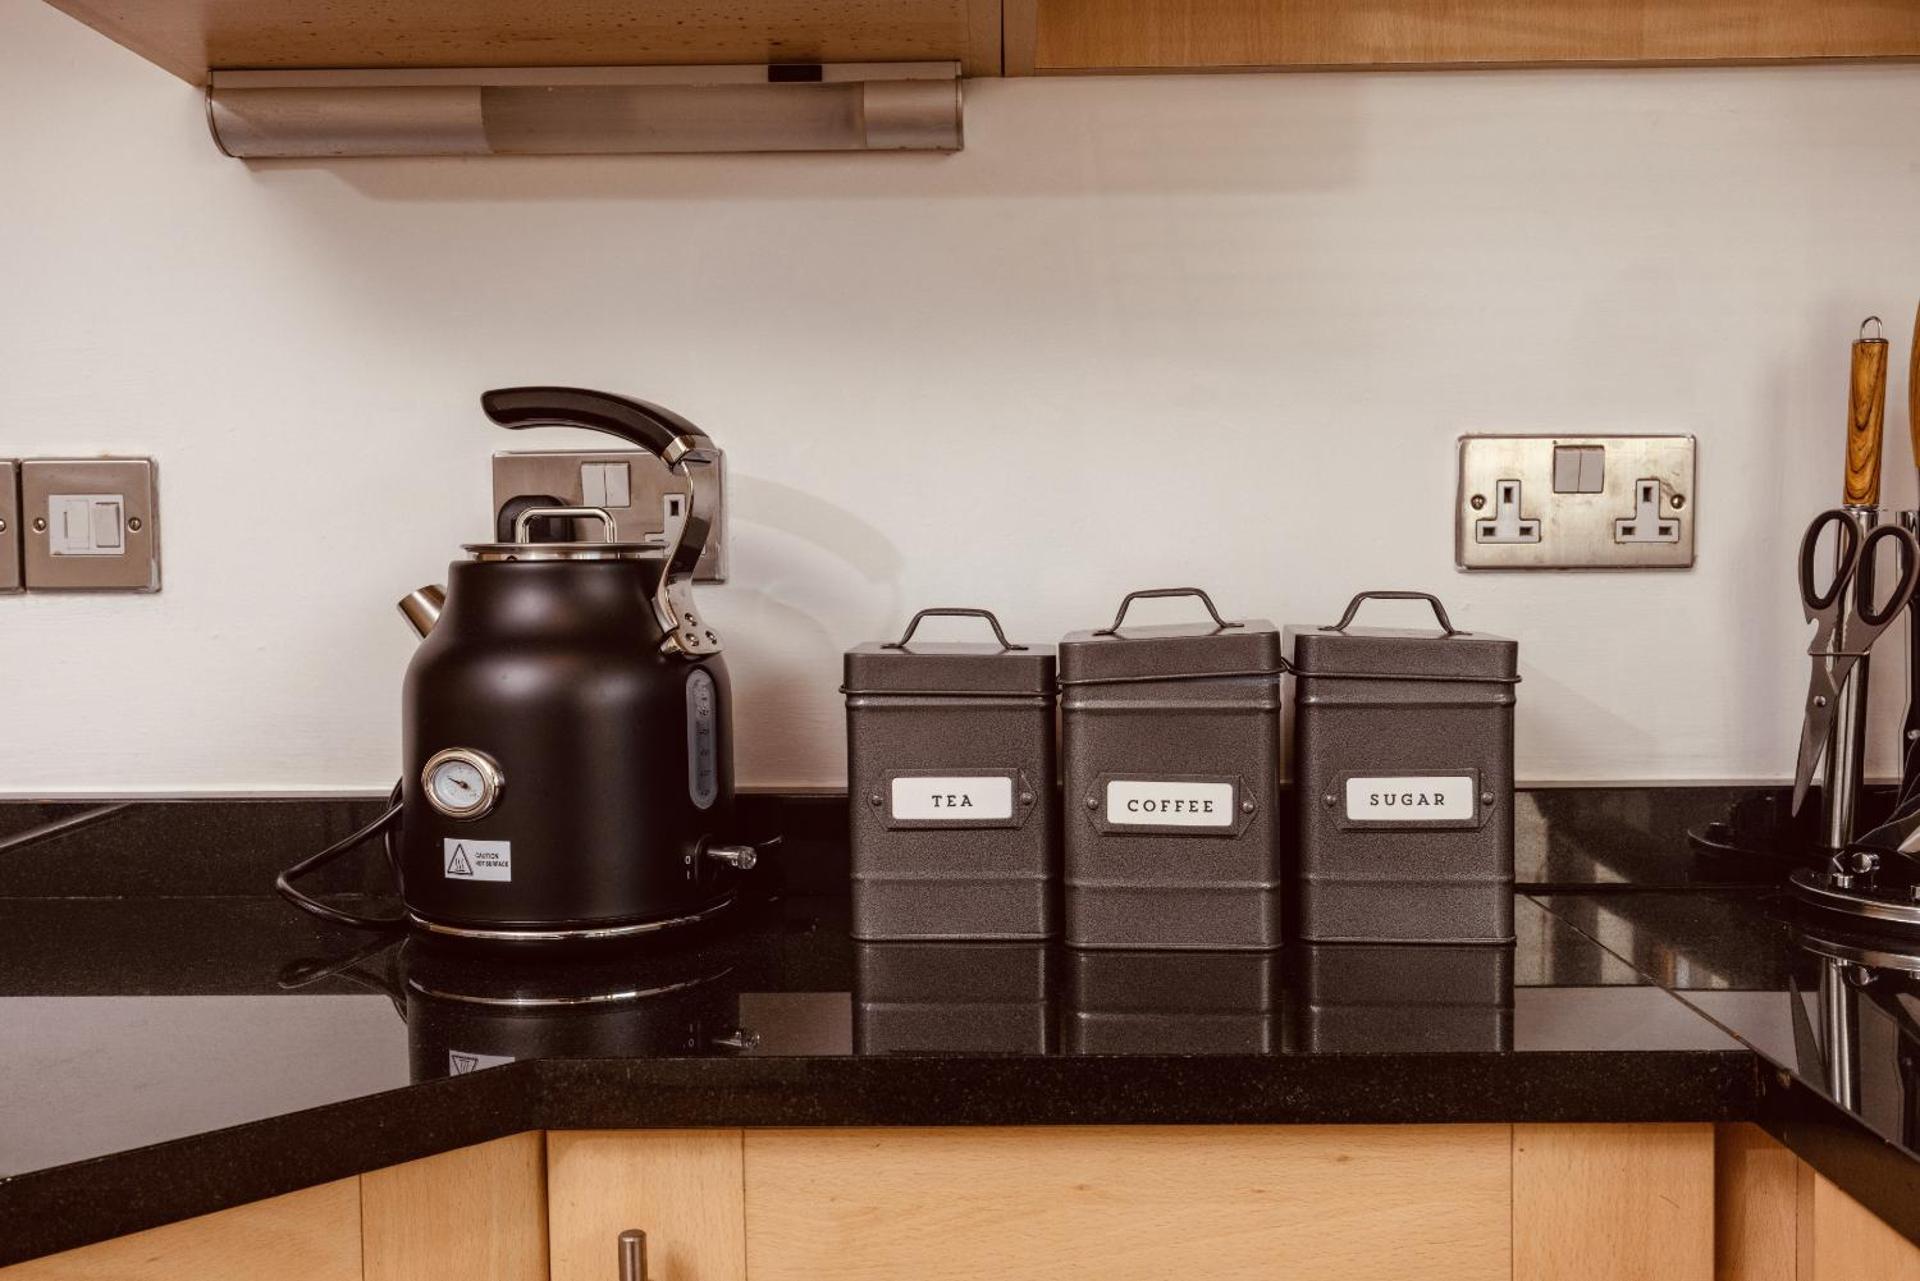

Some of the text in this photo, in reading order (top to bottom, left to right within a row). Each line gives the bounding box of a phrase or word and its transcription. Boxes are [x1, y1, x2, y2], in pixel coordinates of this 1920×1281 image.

[931, 794, 973, 808] TEA
[1127, 799, 1213, 813] COFFEE
[1370, 793, 1445, 806] SUGAR
